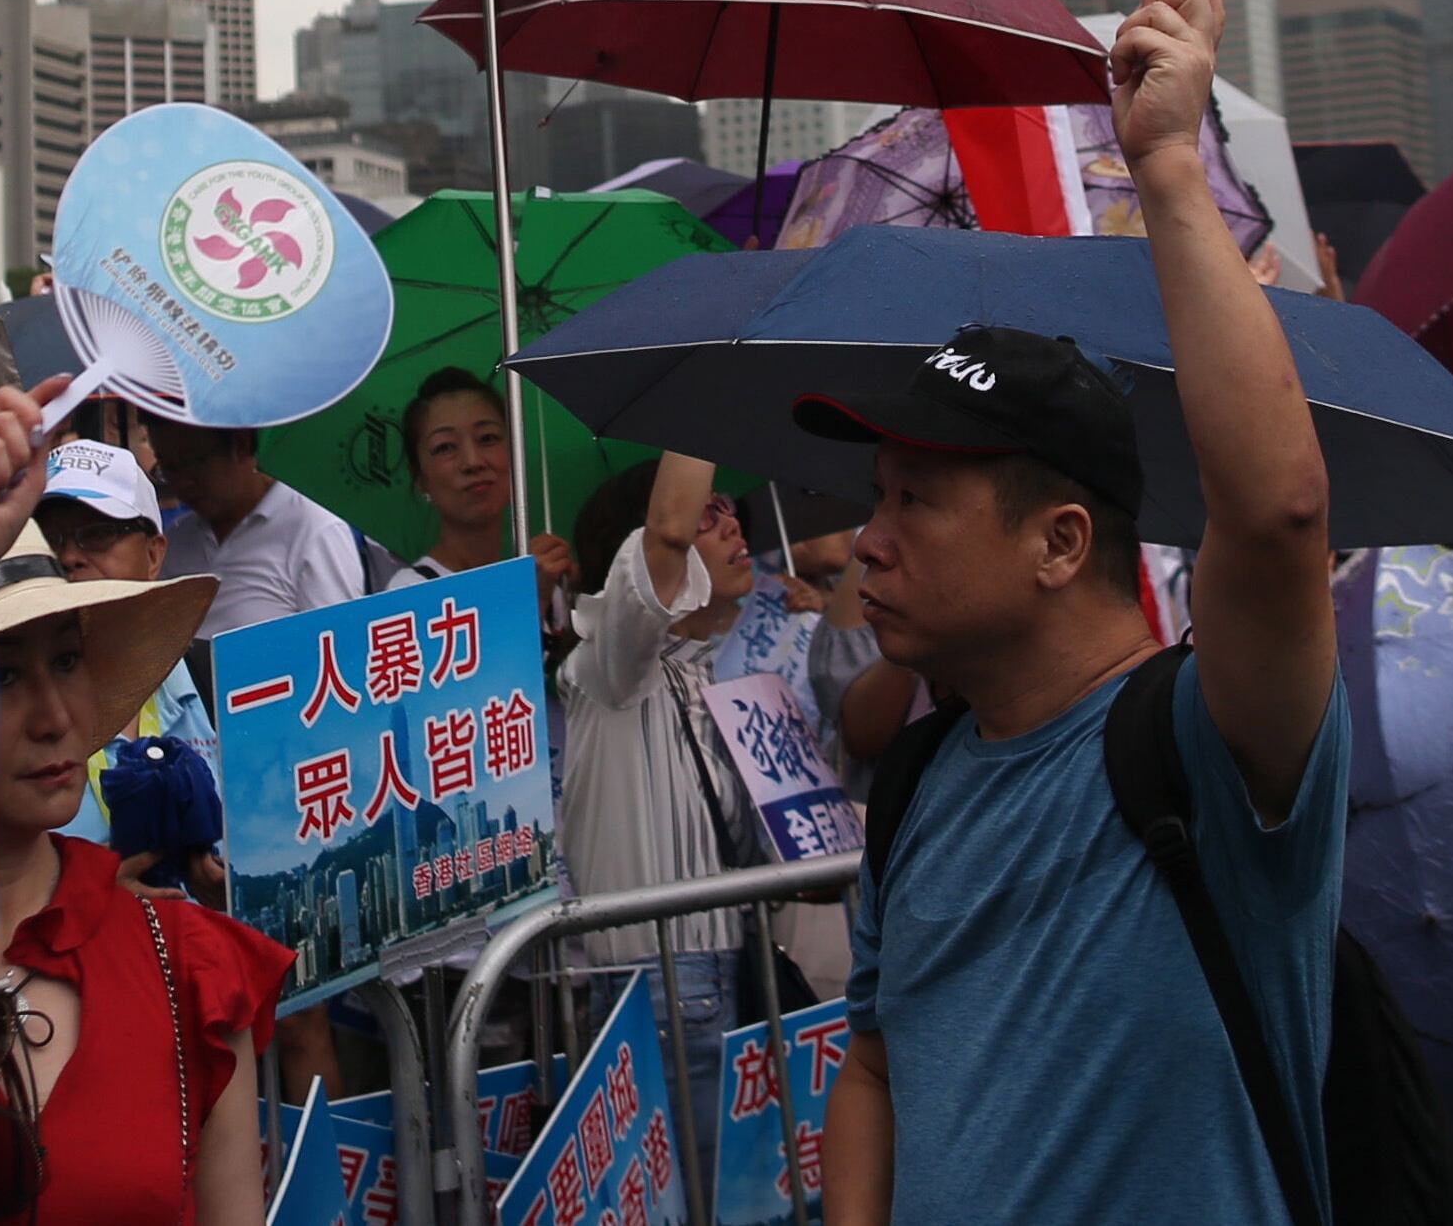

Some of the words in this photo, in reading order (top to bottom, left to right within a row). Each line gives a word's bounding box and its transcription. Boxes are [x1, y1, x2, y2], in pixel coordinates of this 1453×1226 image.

[228, 170, 246, 180] THE
[248, 170, 277, 184] YOUTH
[277, 178, 304, 203] GROUP
[229, 599, 479, 724] 一人暴力
[295, 690, 536, 845] 眾人皆輸
[412, 825, 533, 898] 香港社區網絡
[601, 1109, 672, 1226] 香港
